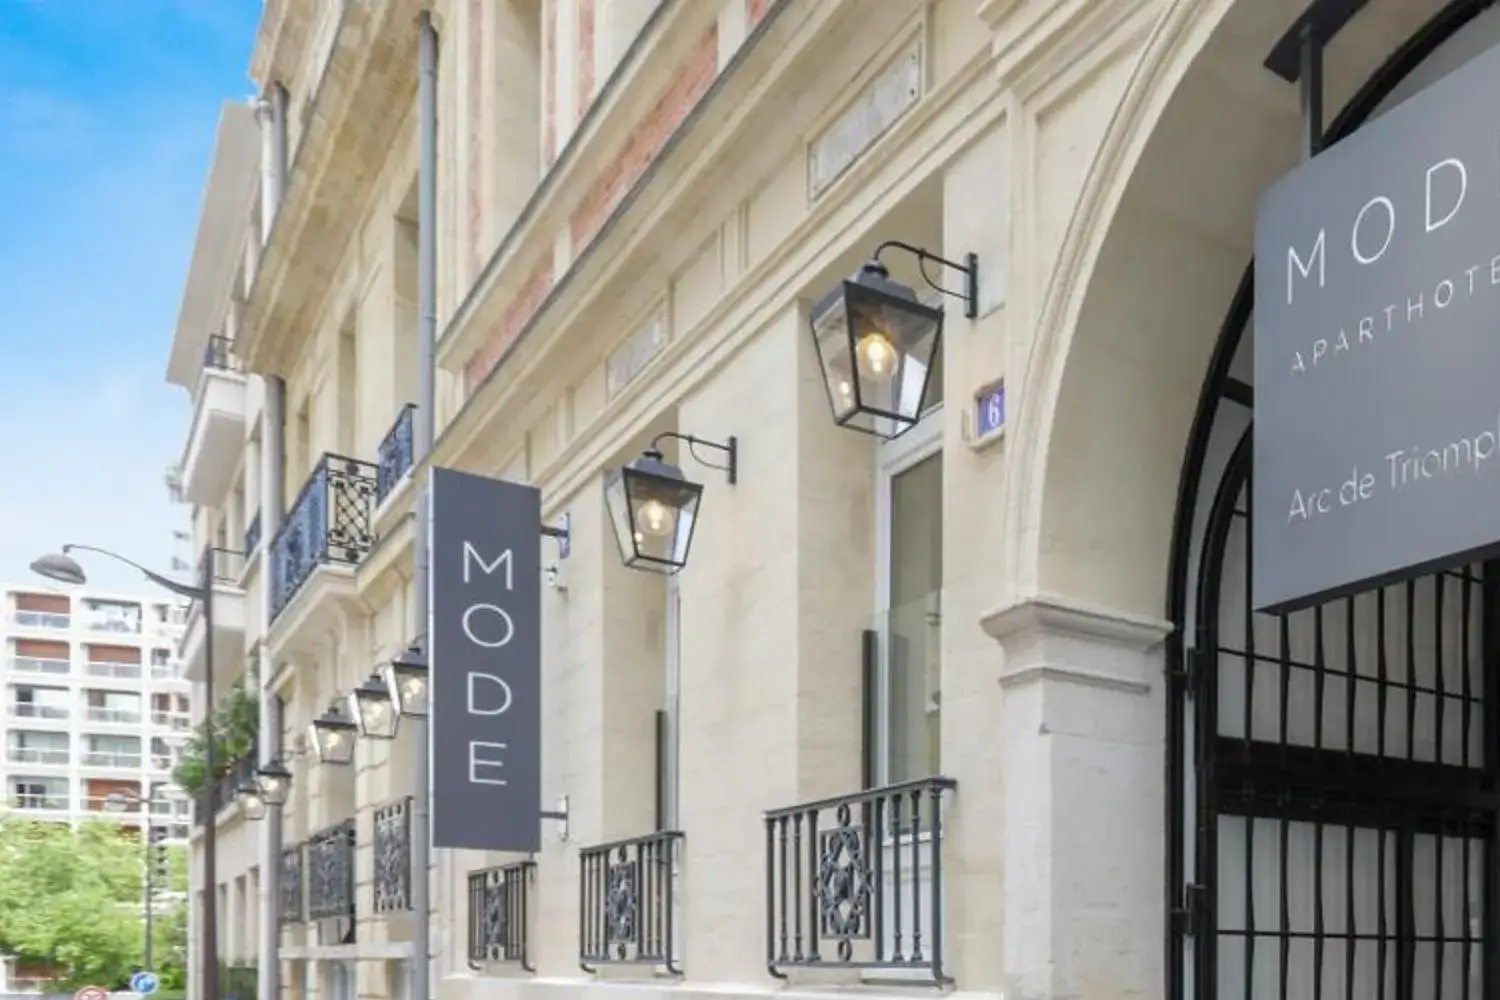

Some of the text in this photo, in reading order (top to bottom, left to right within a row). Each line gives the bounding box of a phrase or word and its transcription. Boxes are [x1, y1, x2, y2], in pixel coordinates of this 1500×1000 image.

[988, 393, 1000, 428] 6
[1286, 487, 1332, 526] Arc
[1338, 463, 1376, 506] de
[462, 540, 515, 786] MODE
